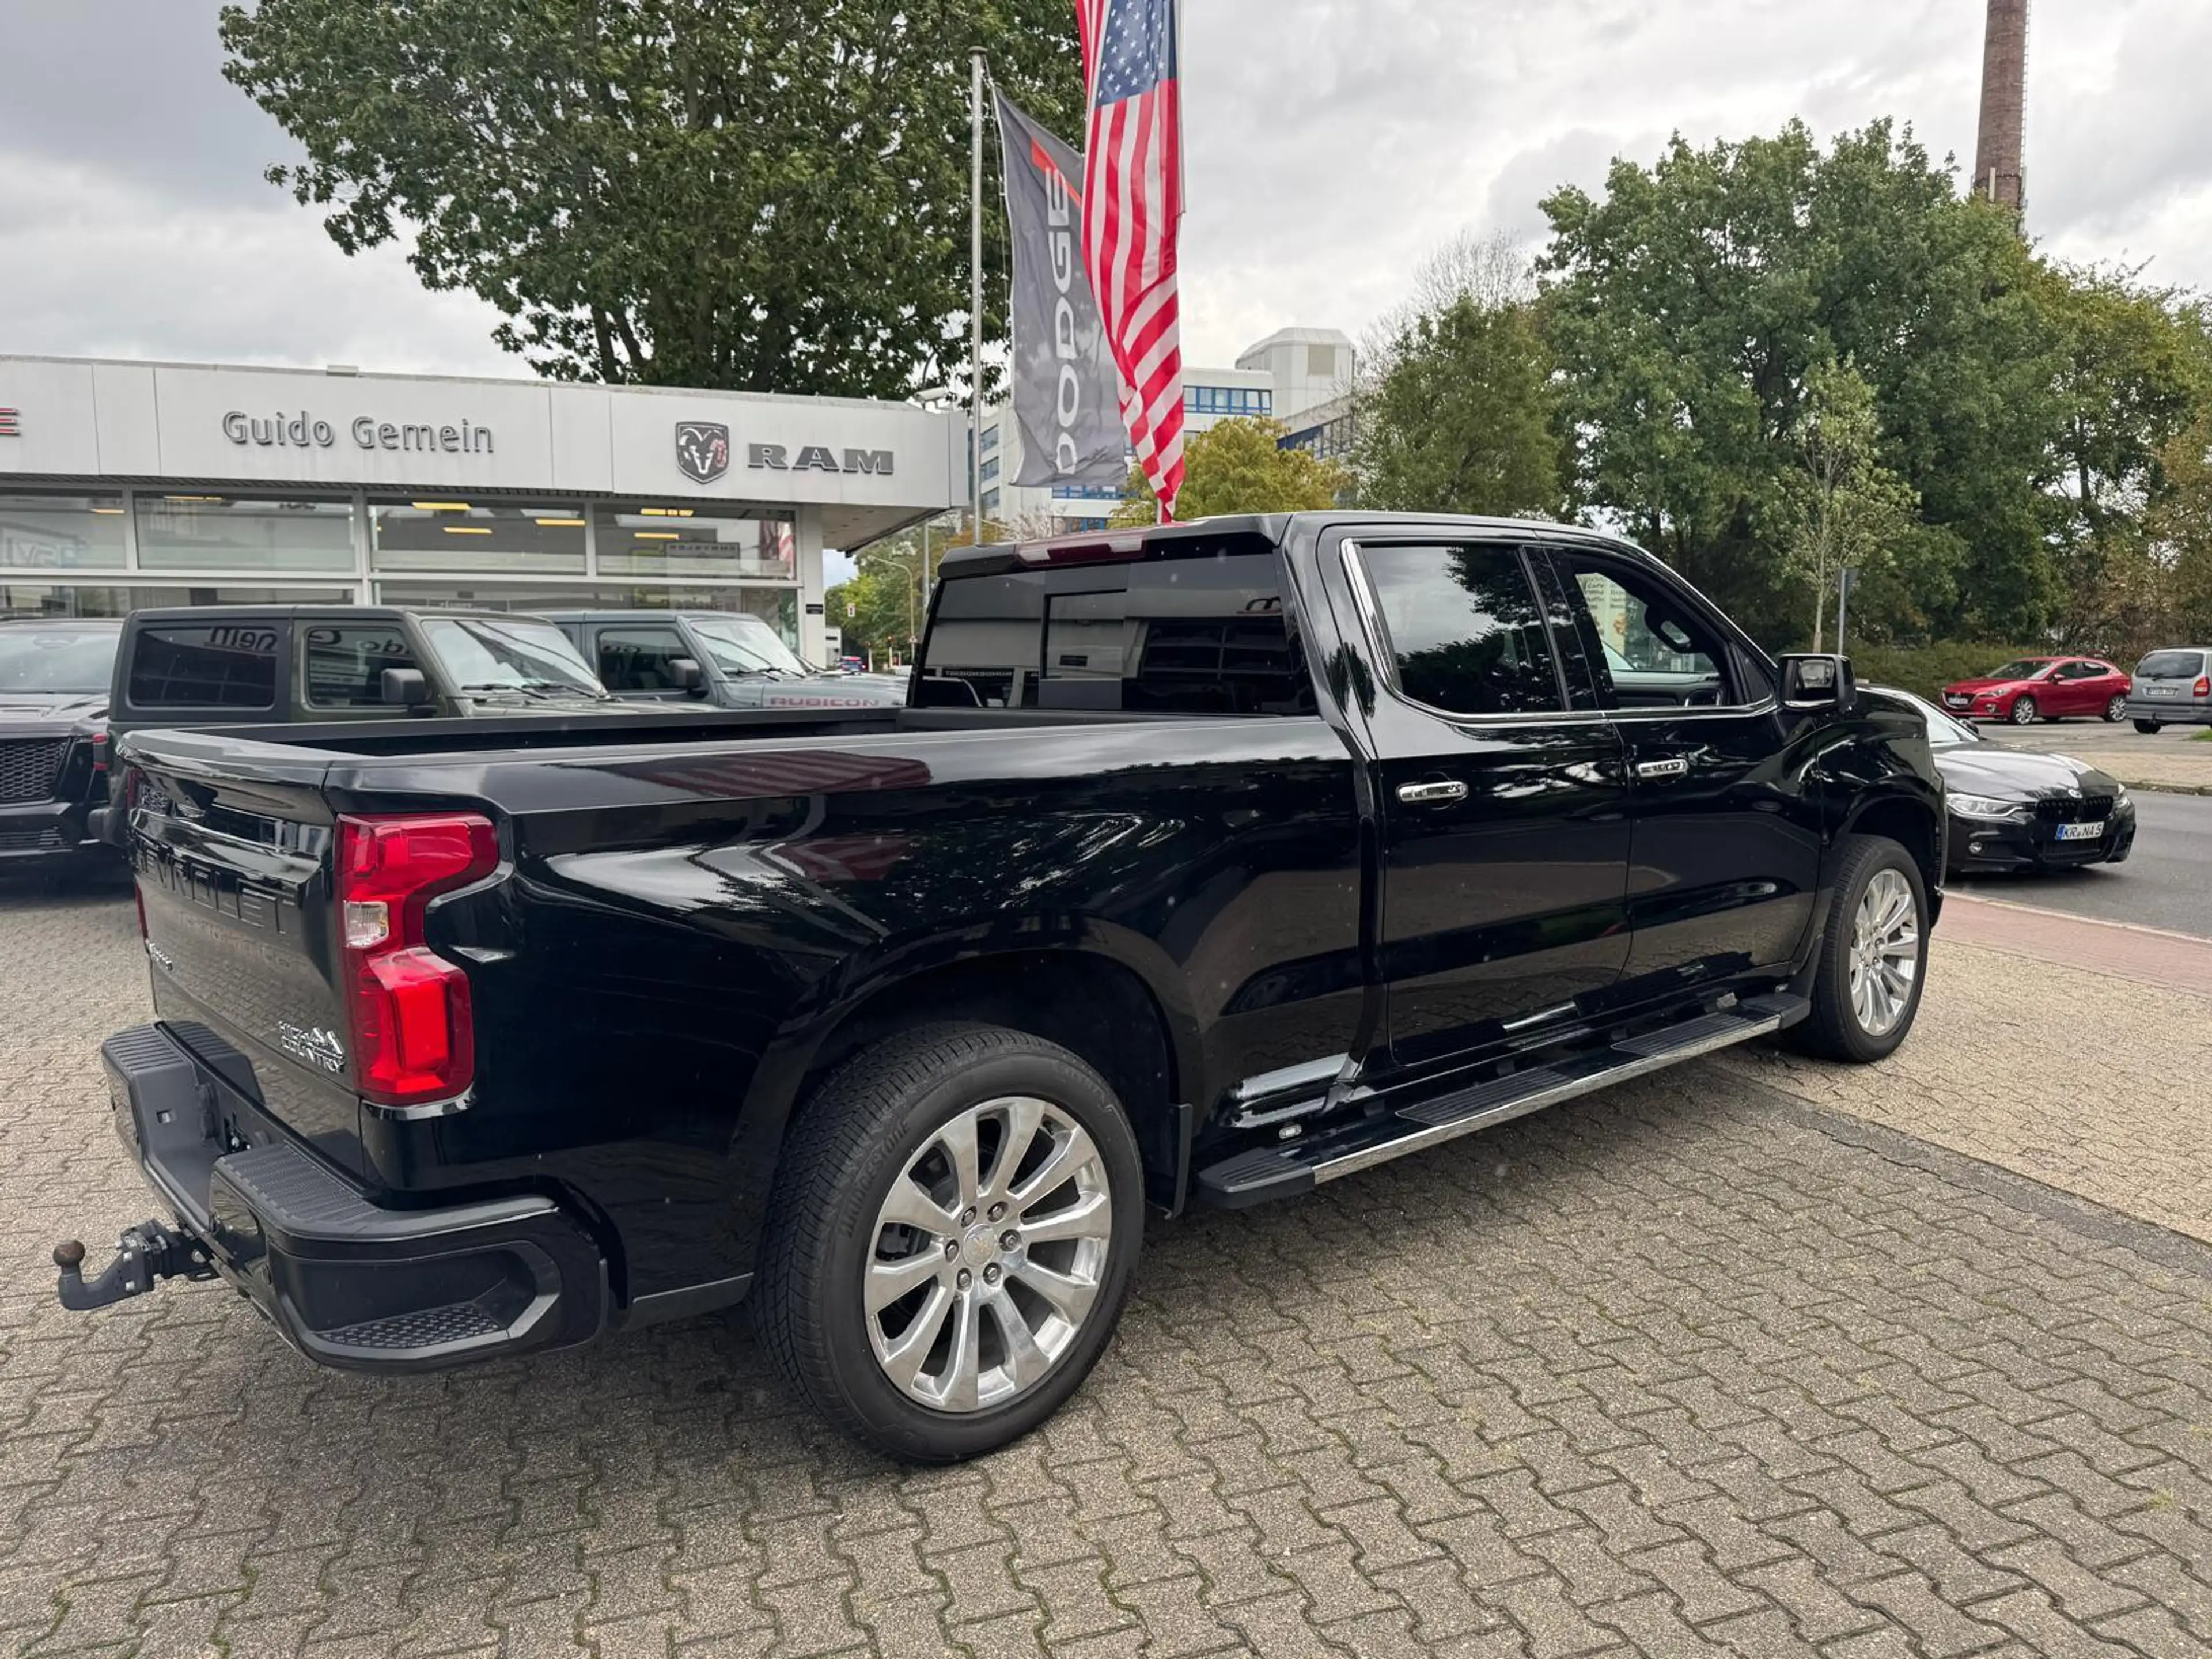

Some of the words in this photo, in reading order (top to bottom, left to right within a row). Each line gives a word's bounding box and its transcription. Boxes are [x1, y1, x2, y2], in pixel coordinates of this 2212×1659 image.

[1045, 166, 1079, 474] DODGE
[222, 410, 334, 448] Guido
[351, 416, 494, 453] Gemein
[747, 442, 894, 475] RAM
[770, 696, 880, 707] RUBICON
[135, 835, 296, 935] HEVROLET
